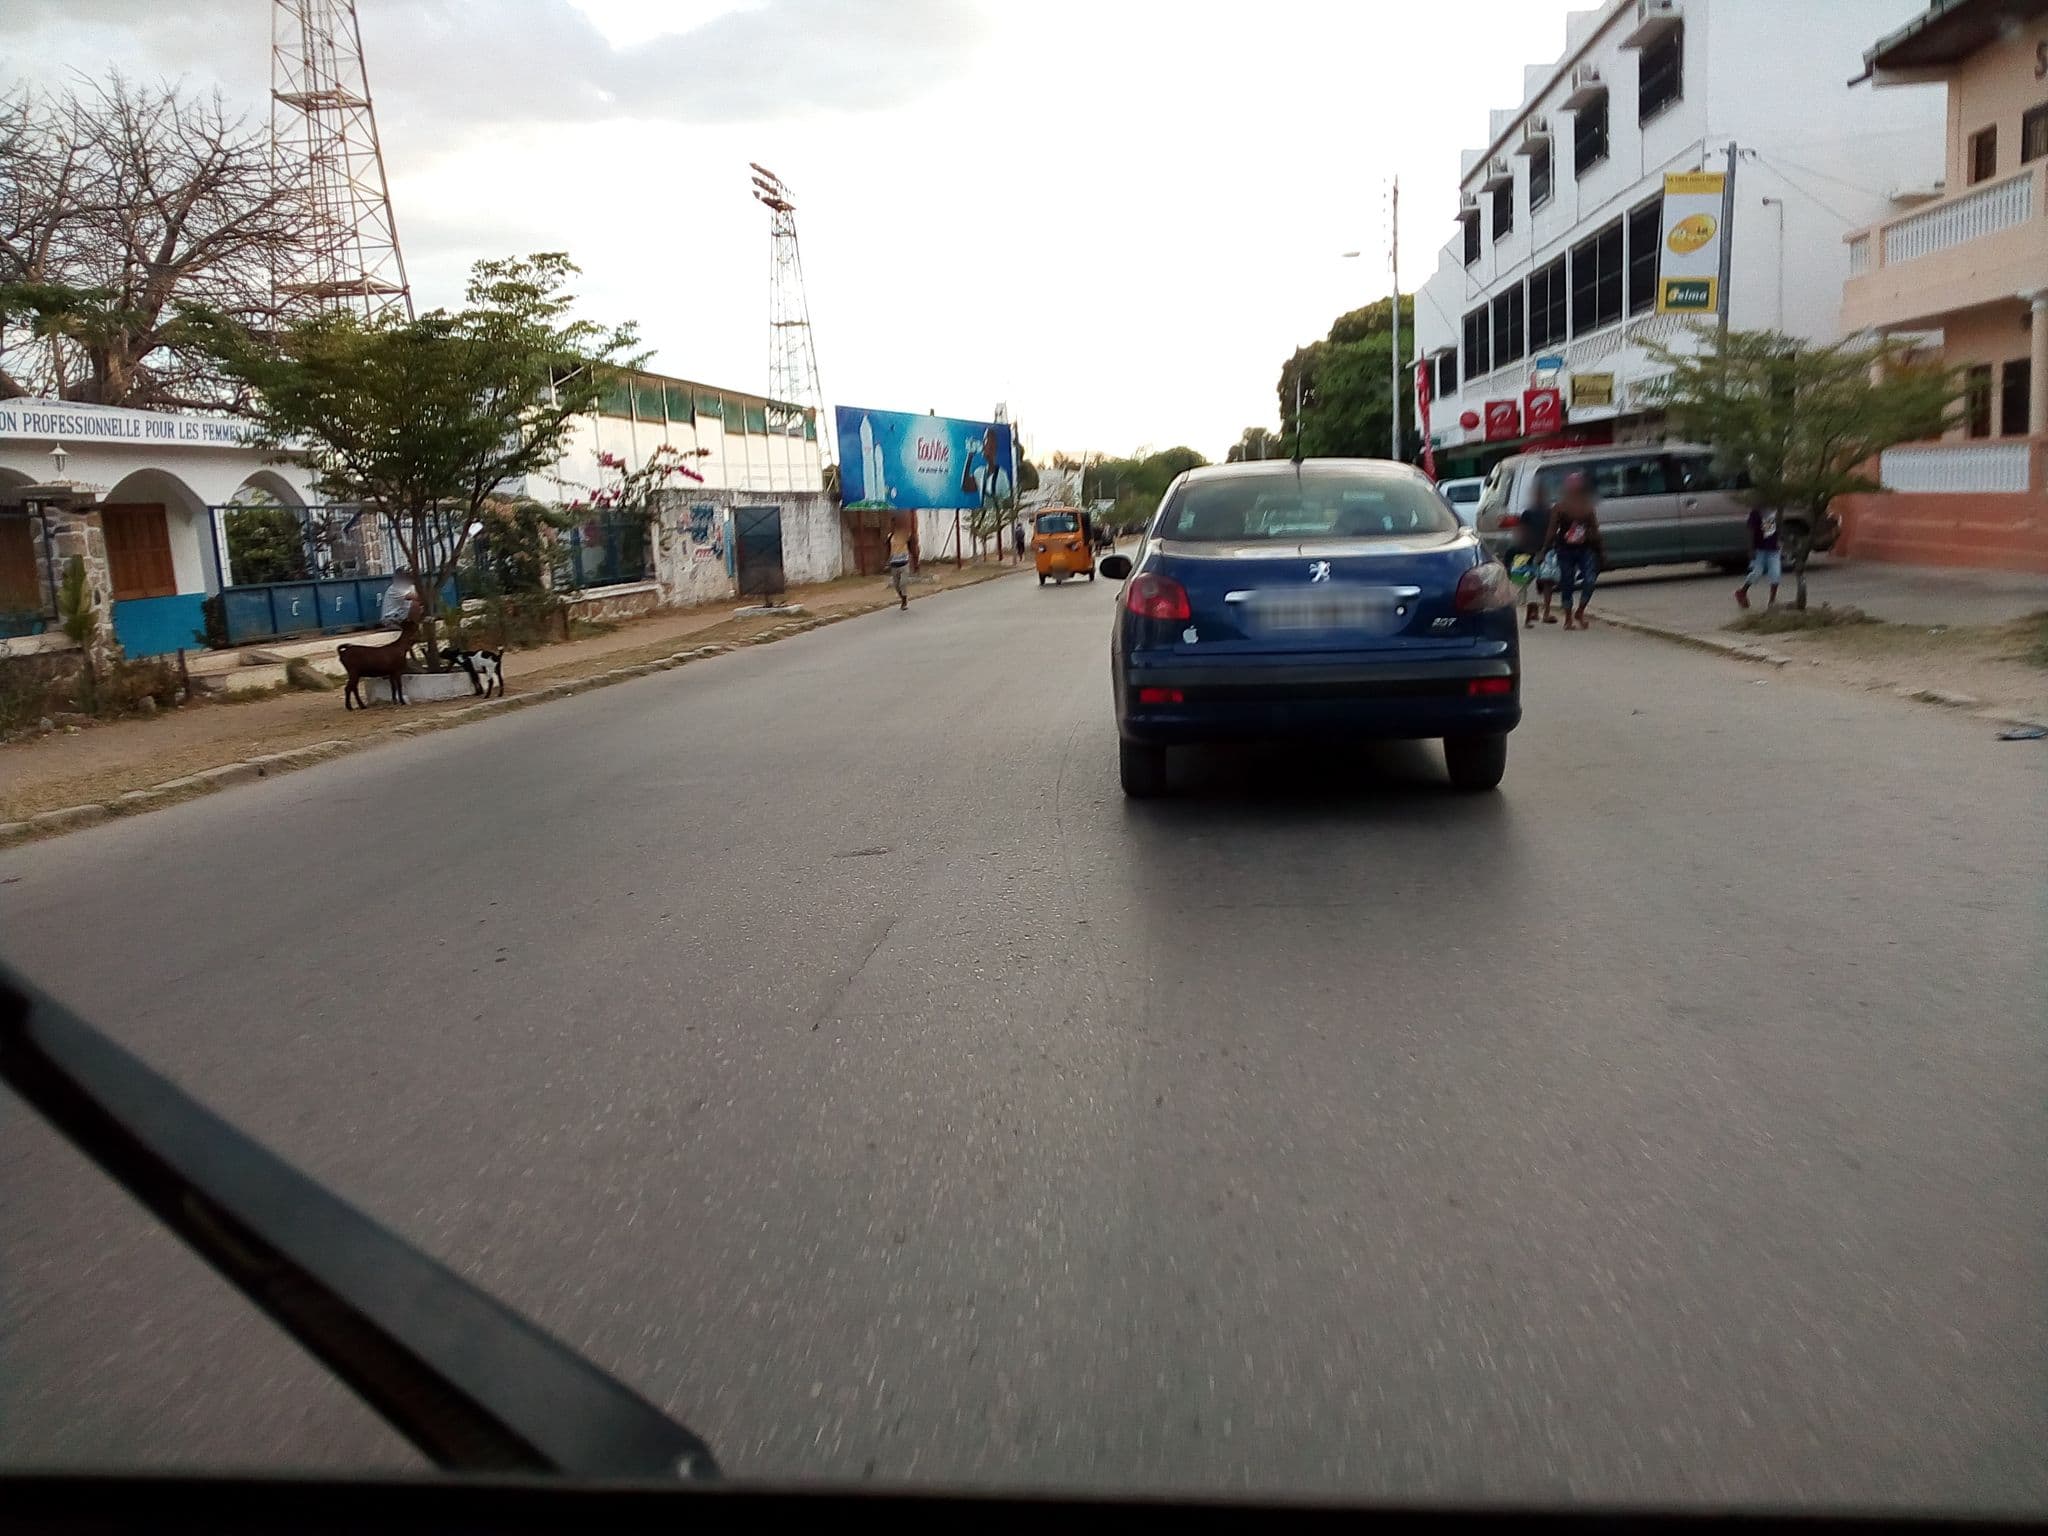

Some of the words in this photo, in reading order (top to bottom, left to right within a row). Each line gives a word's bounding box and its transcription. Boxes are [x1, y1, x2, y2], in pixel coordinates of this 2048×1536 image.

[23, 413, 140, 437] PROFESSIONNELLE
[146, 420, 175, 439] POUR
[179, 422, 199, 440] LES
[203, 423, 241, 442] FEMMES
